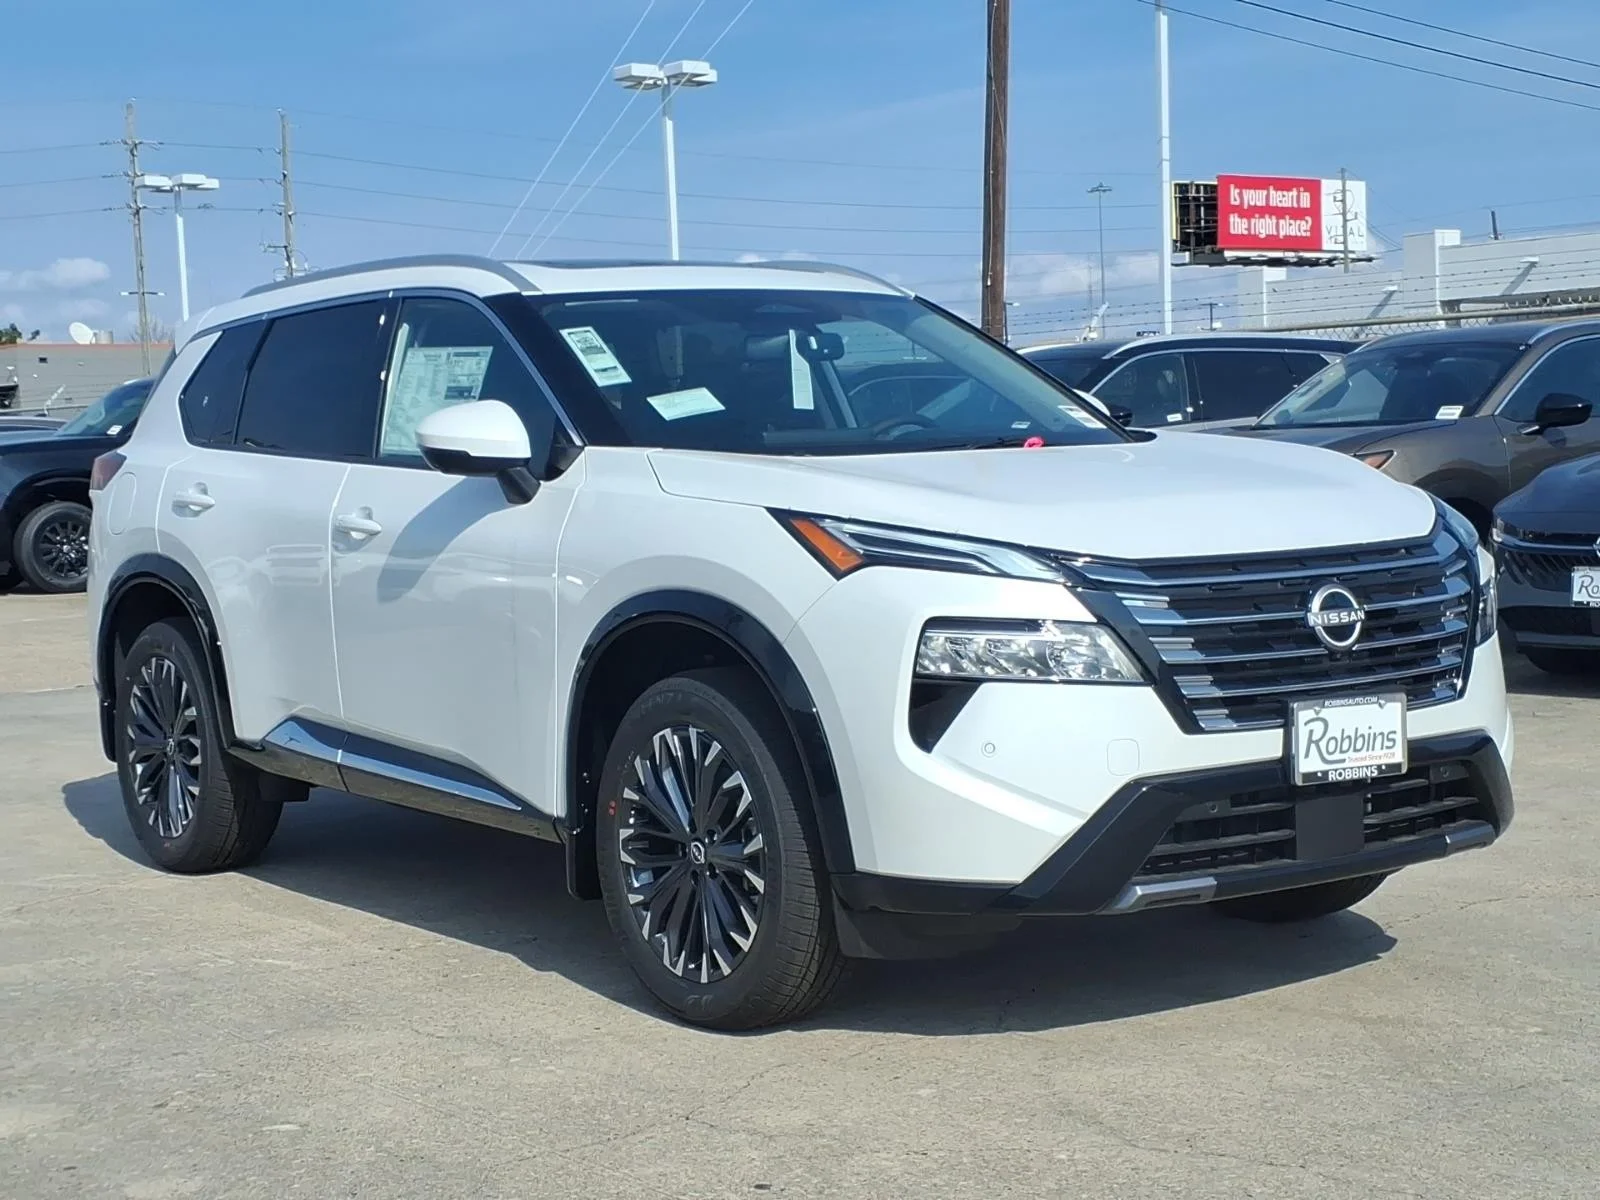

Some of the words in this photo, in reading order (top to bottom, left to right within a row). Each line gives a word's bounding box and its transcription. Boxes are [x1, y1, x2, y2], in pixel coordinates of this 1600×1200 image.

[1230, 184, 1240, 205] Is
[1242, 189, 1267, 209] your
[1269, 185, 1298, 208] heart
[1300, 187, 1310, 208] in
[1229, 213, 1248, 235] the
[1251, 213, 1277, 238] right
[1279, 215, 1312, 239] place?
[1325, 224, 1365, 237] VIAL
[1308, 609, 1365, 627] NISSAN
[1304, 717, 1397, 765] Robbins
[1328, 765, 1378, 781] ROBBINS
